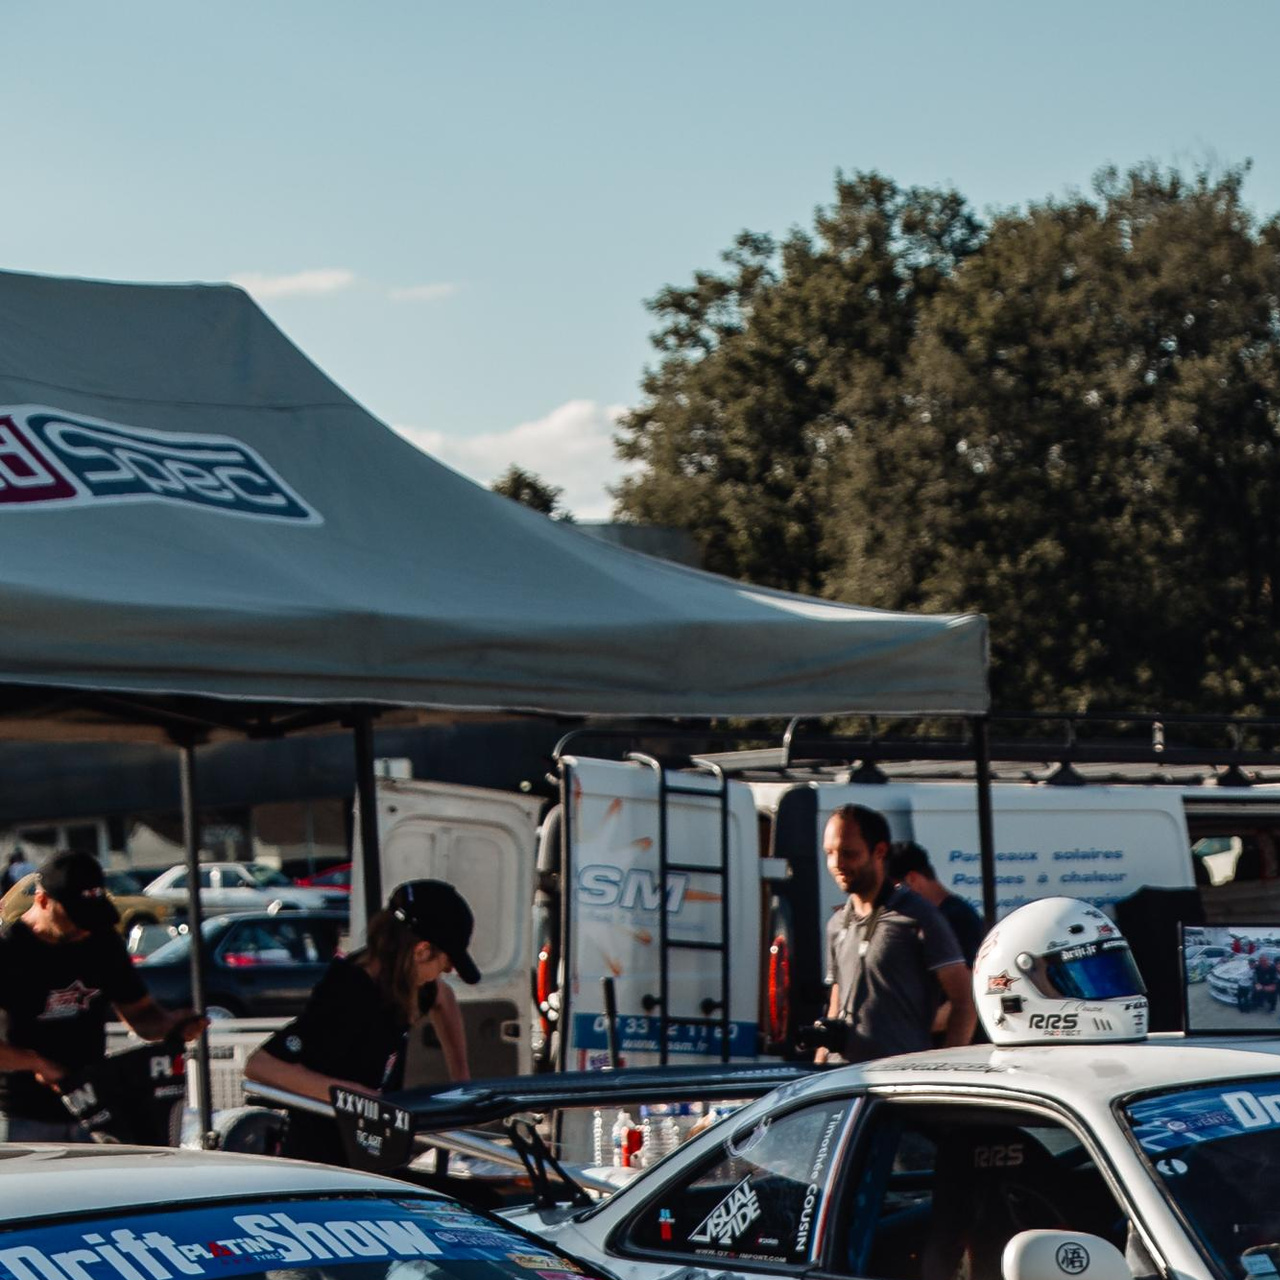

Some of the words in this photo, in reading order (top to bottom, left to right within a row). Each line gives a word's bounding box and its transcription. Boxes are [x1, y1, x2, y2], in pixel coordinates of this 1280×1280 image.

[577, 864, 692, 915] SM
[1028, 1013, 1079, 1030] RRS
[810, 1109, 845, 1180] Timothée
[232, 1211, 444, 1263] Show
[795, 1183, 820, 1252] COUSIN
